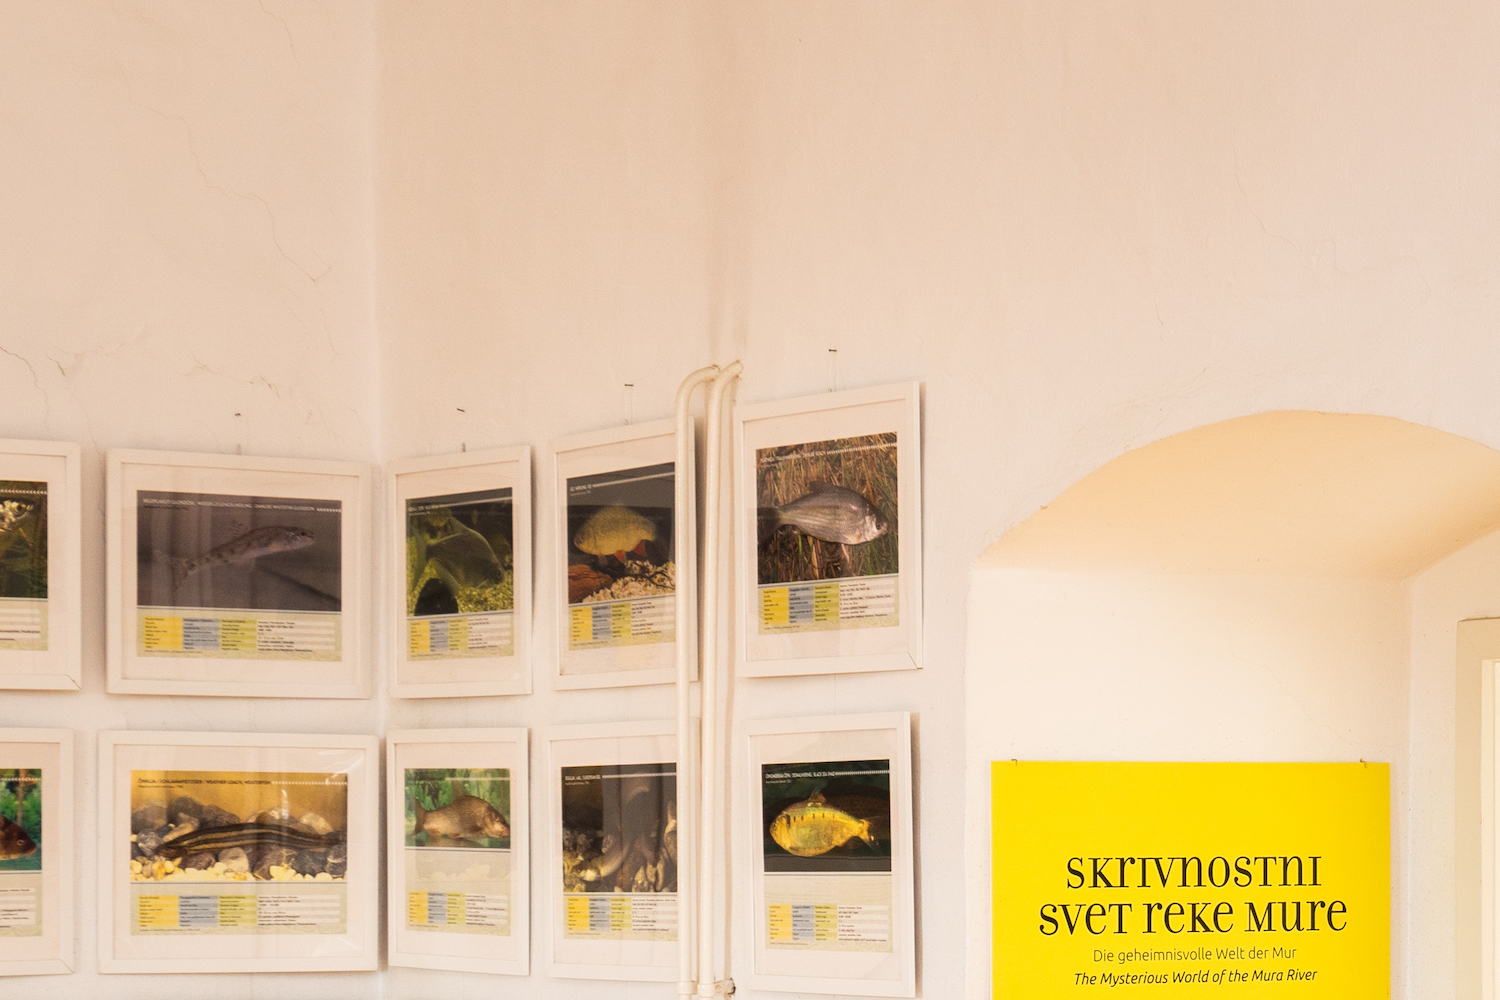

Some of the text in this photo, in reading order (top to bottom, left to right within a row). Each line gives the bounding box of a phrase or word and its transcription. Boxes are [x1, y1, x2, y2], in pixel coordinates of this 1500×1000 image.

[1093, 946, 1297, 965] Die geheimnisvolle Welt der Mur
[1074, 968, 1318, 988] The Mysterious World of the Mura River
